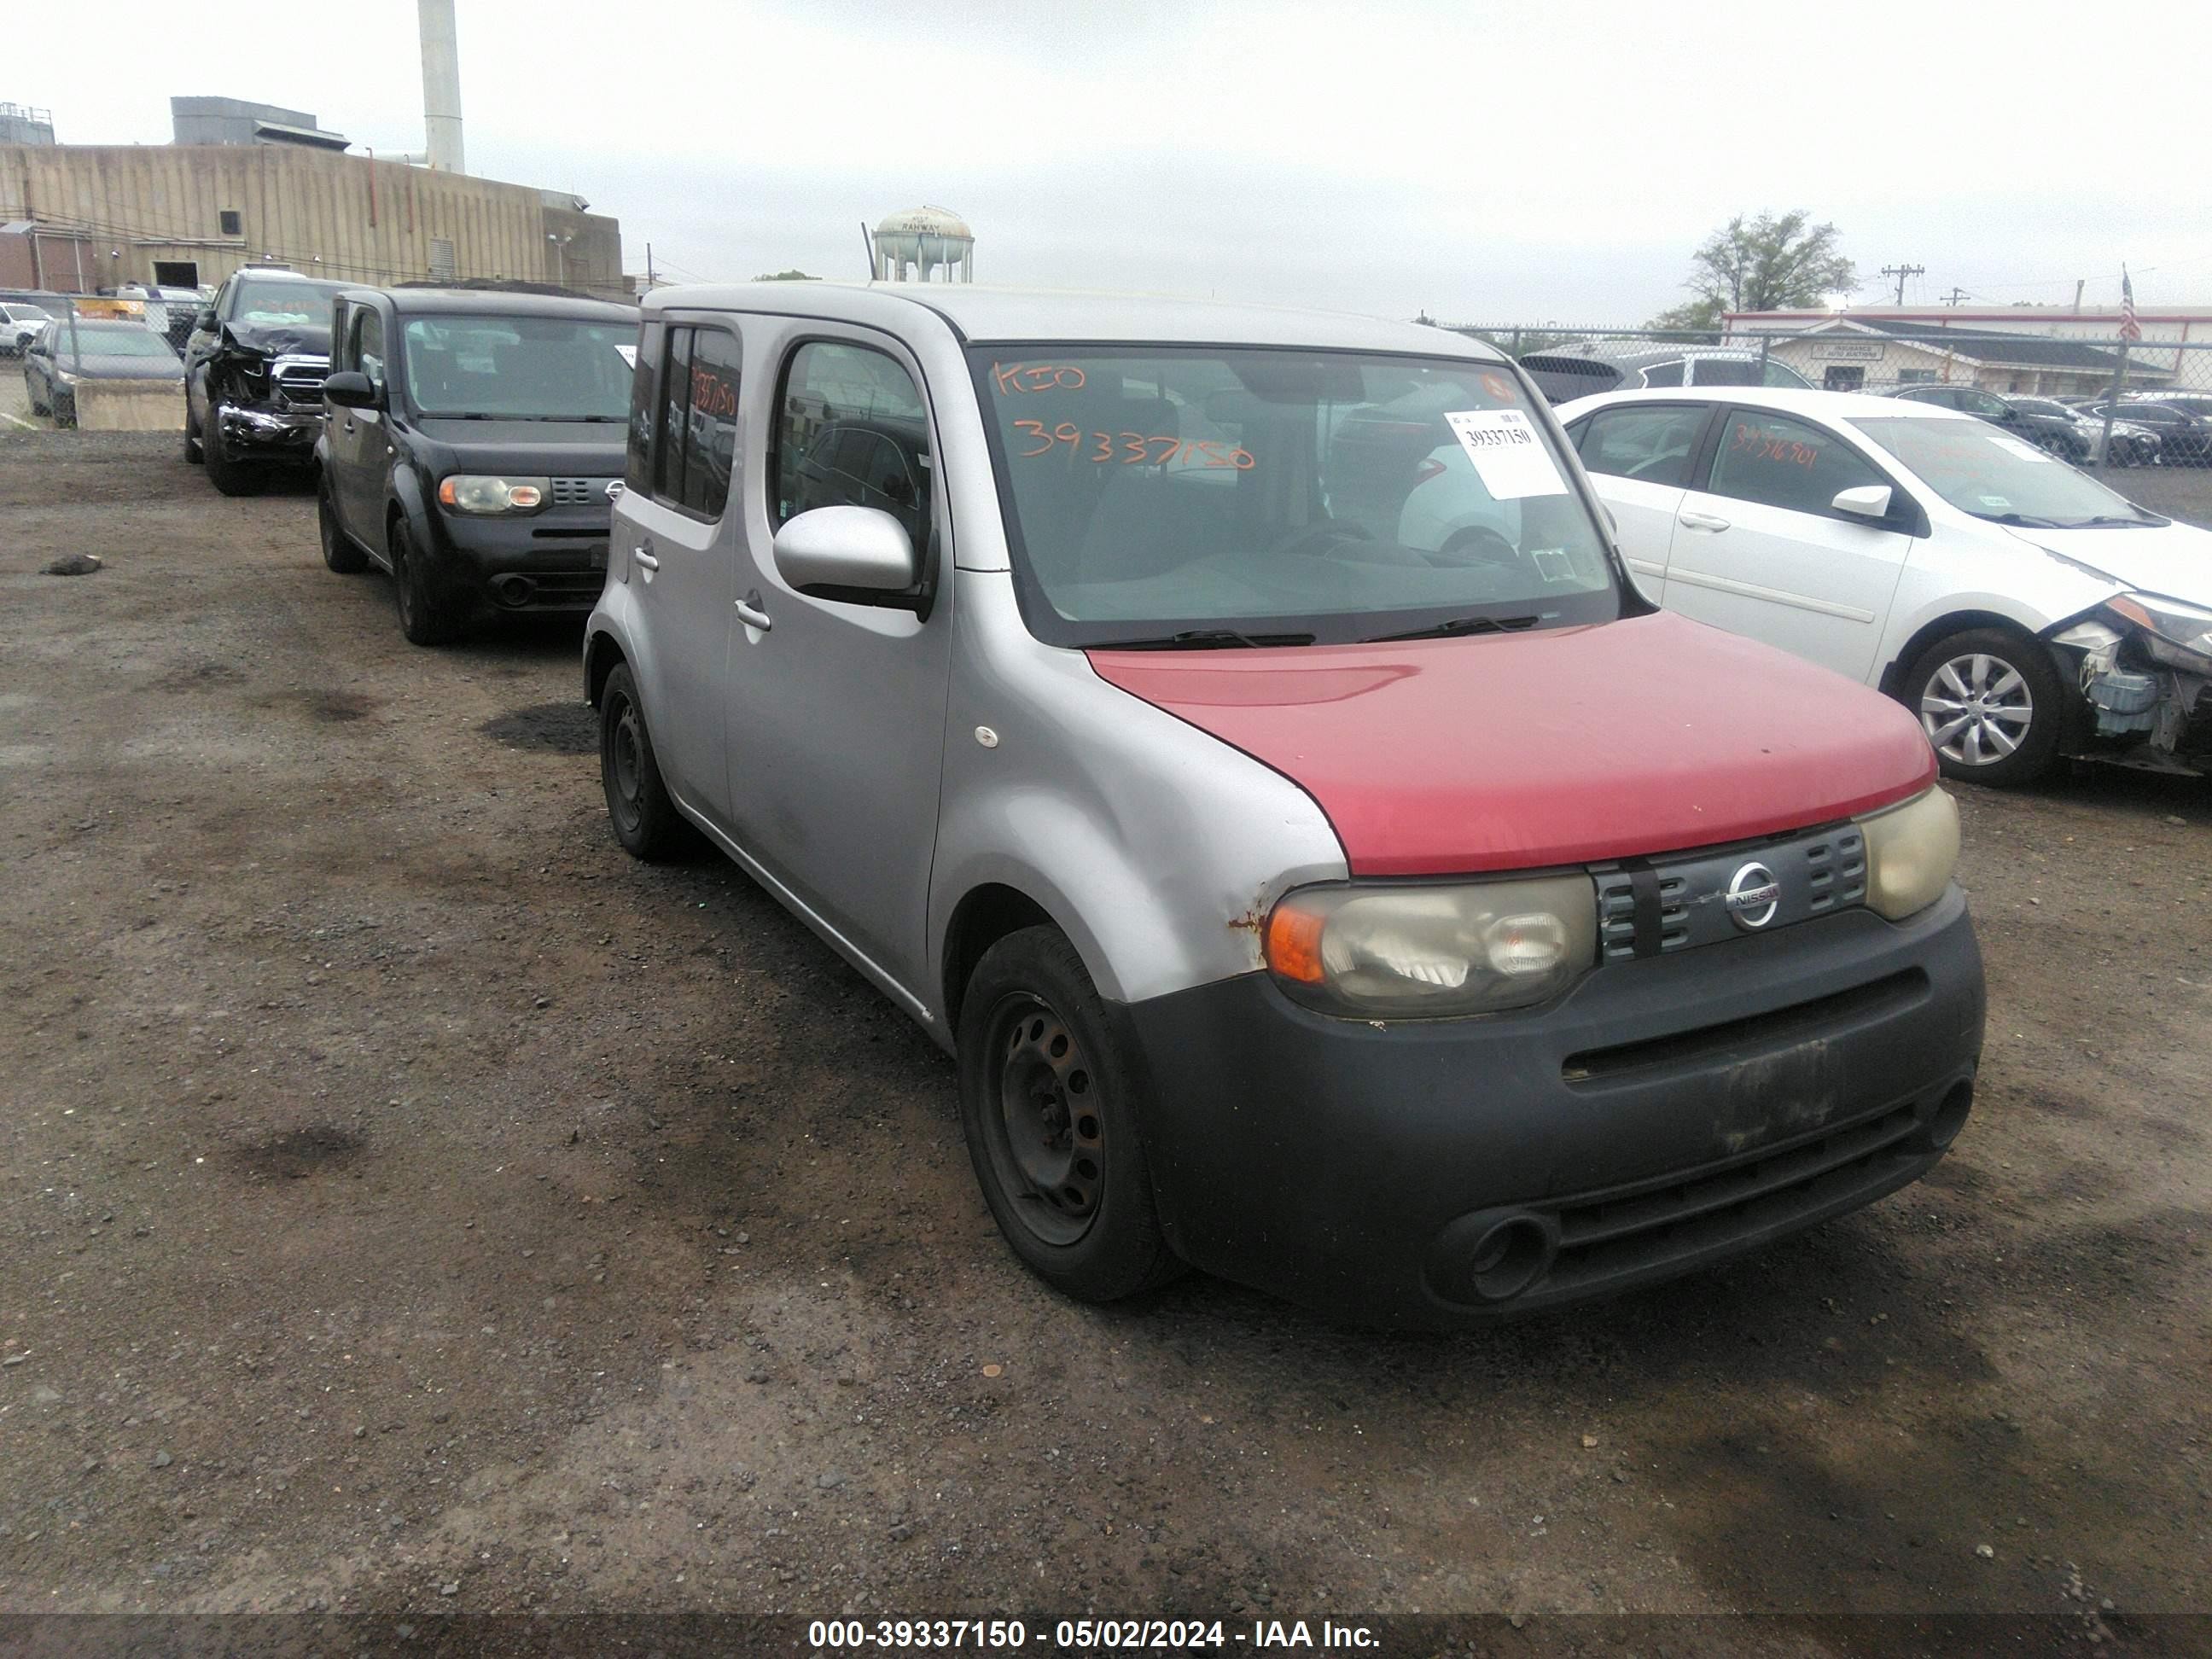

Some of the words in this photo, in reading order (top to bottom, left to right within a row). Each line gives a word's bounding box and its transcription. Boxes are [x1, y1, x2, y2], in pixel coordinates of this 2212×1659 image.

[902, 223, 940, 231] RAHWAY
[1014, 419, 1254, 469] 39337150
[1466, 428, 1532, 447] 39337150
[1735, 888, 1778, 906] NISSAN
